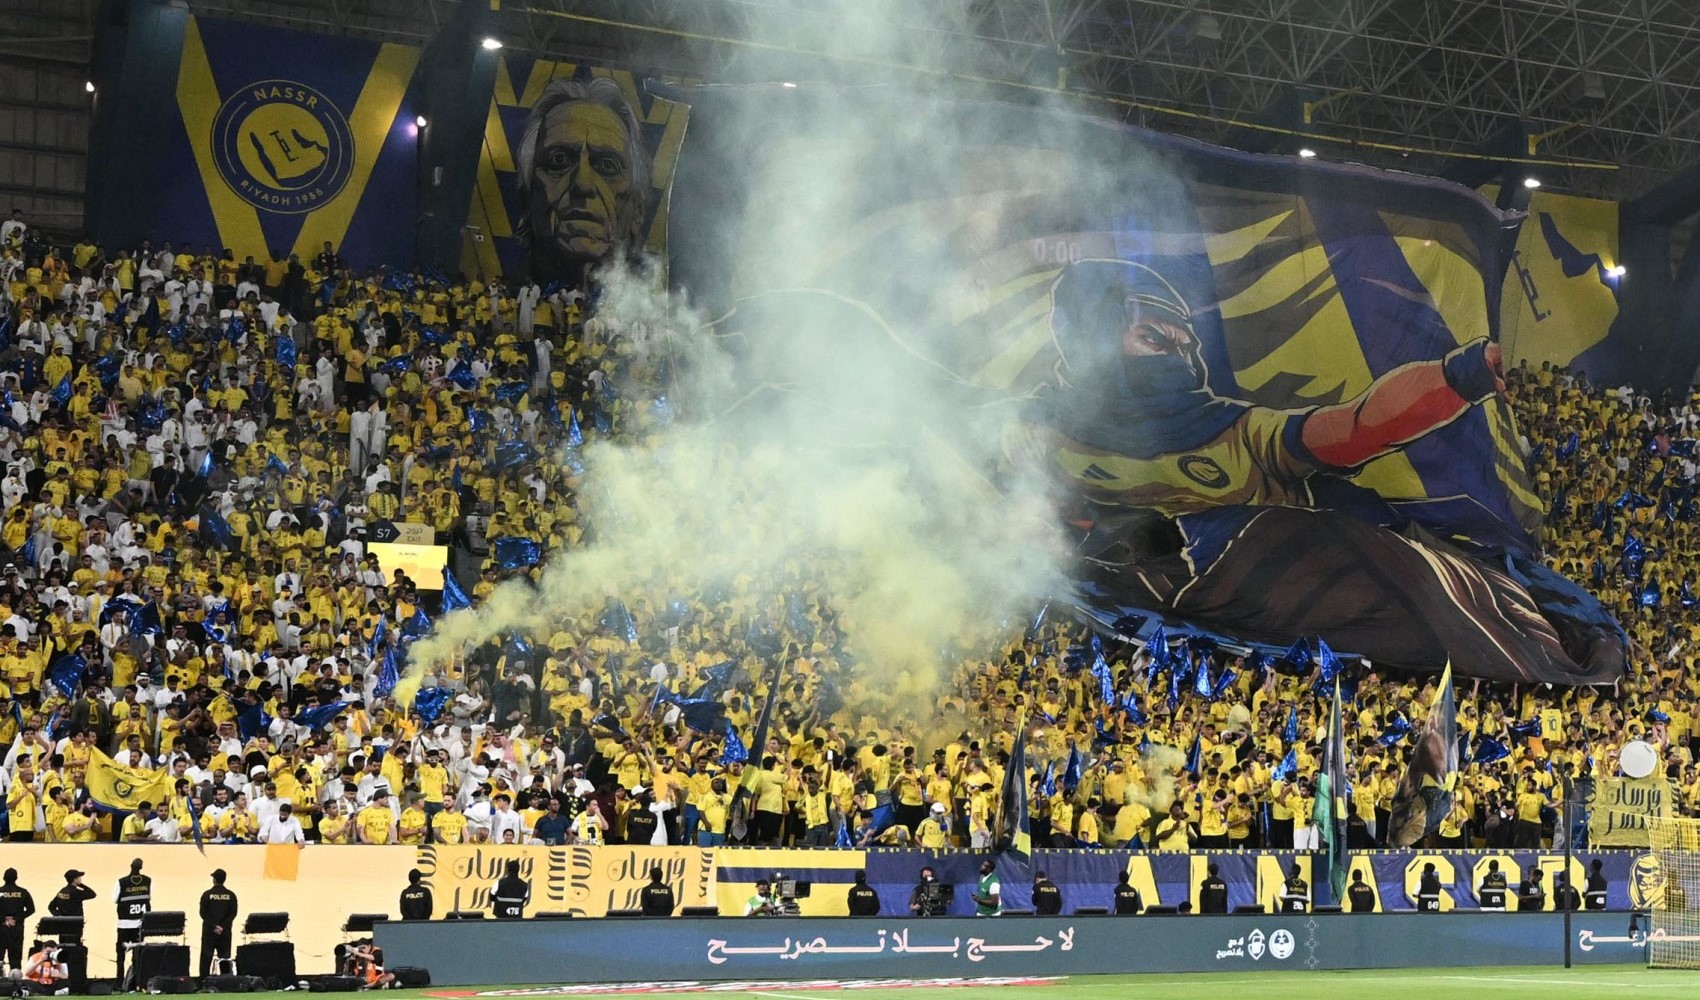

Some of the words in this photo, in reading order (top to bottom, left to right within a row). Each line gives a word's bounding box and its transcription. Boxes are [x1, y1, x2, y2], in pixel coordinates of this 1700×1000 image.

[253, 86, 318, 109] NASSR
[240, 179, 290, 206] RIYADH
[296, 188, 324, 205] 1955
[376, 528, 391, 539] S7
[633, 816, 652, 824] POLICE
[405, 891, 424, 899] POLICE
[129, 903, 147, 915] 204
[706, 928, 887, 964] تصريح
[891, 928, 960, 960] بلا
[966, 934, 1053, 962] حج
[1058, 926, 1075, 951] لا
[1578, 928, 1700, 952] صريح
